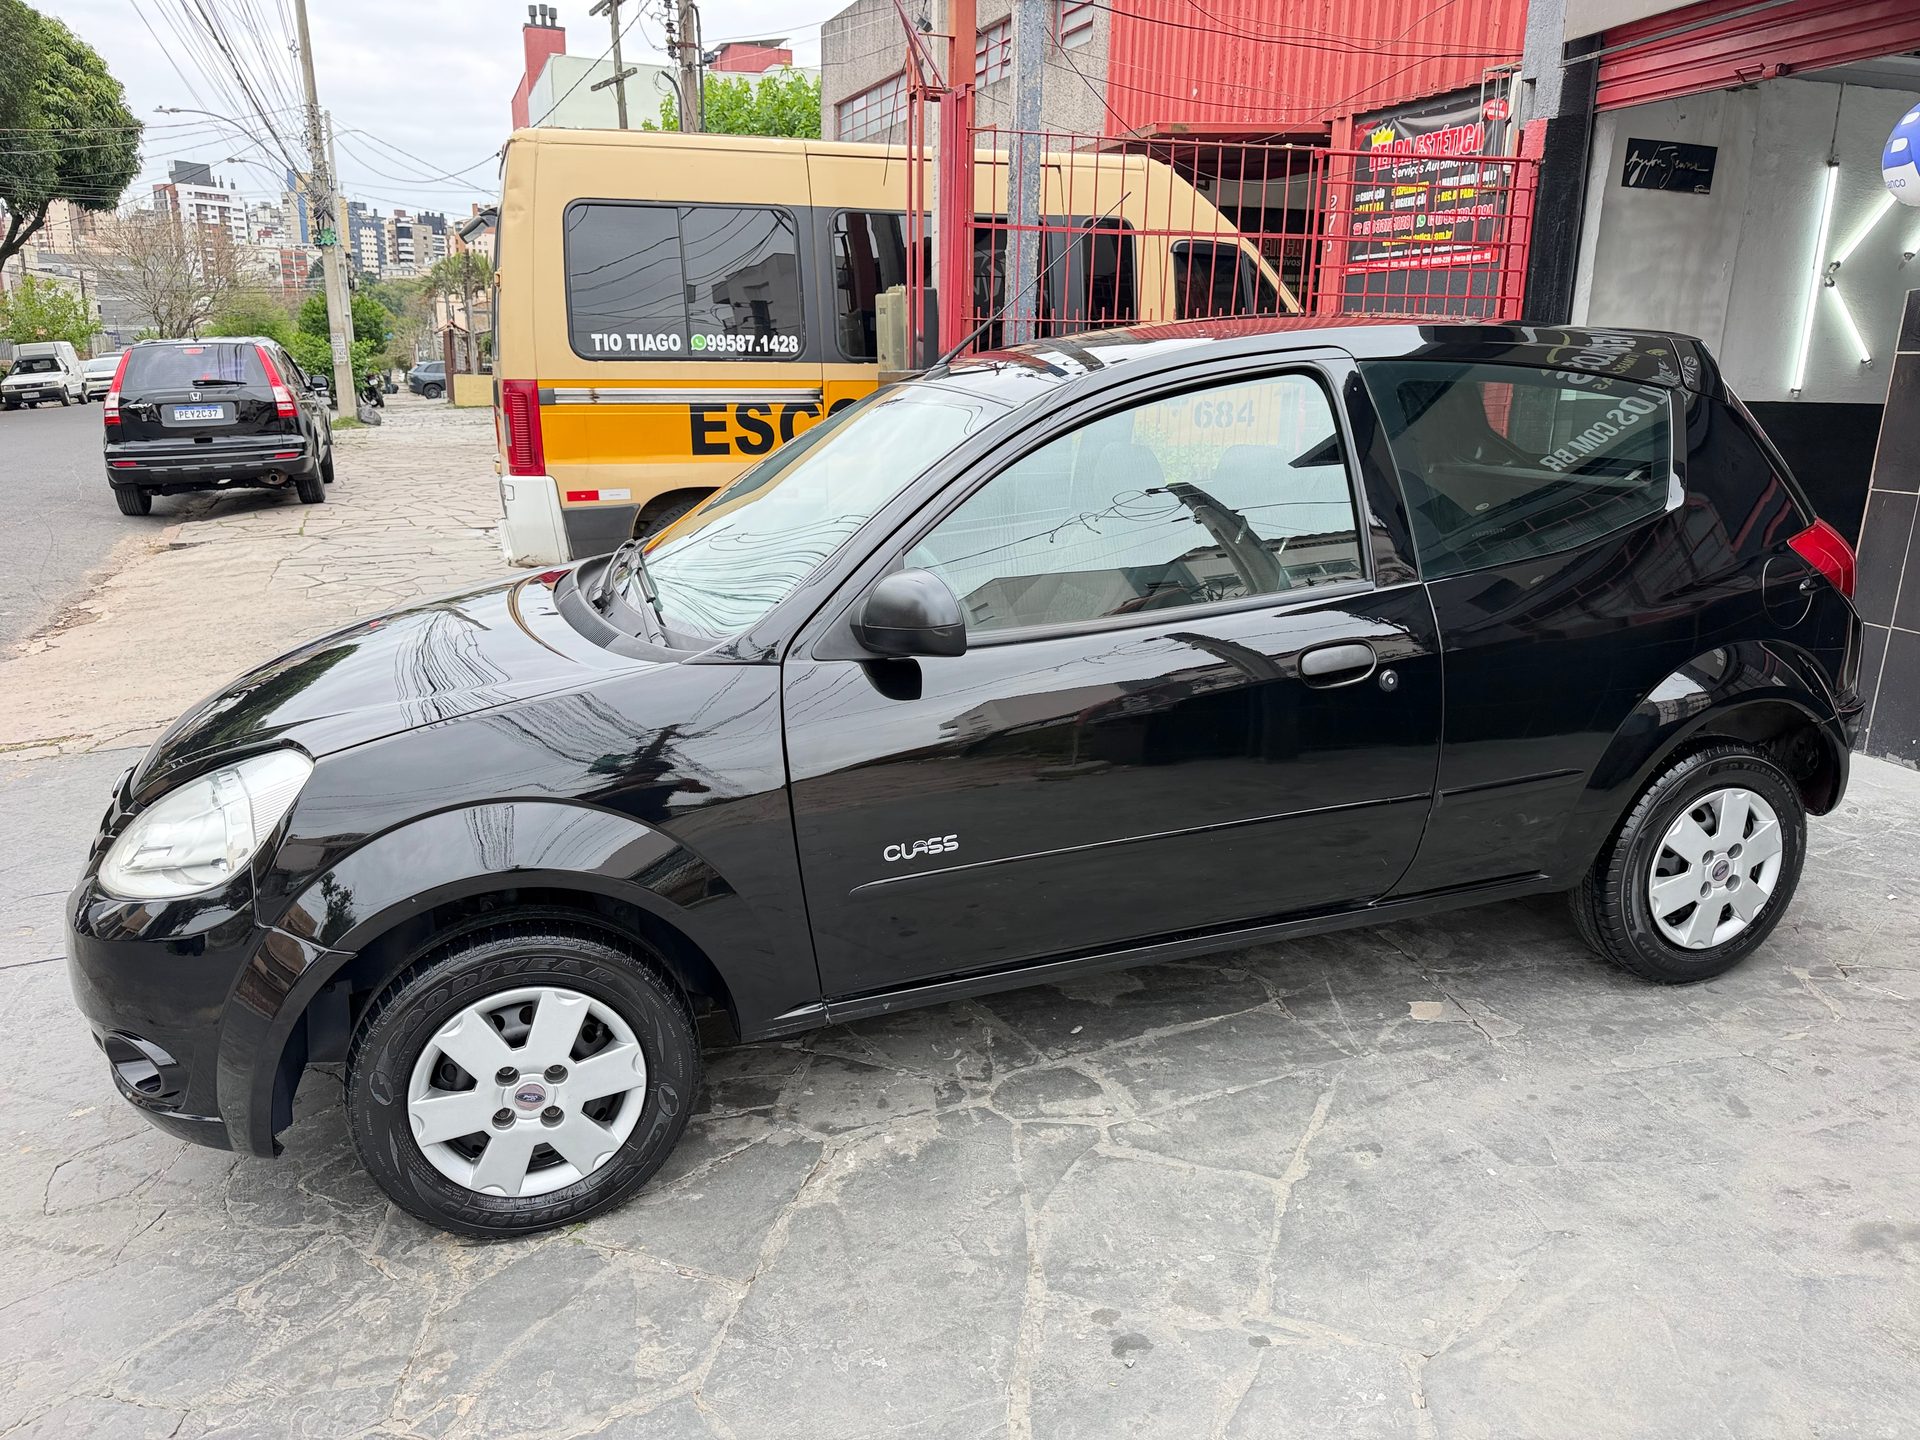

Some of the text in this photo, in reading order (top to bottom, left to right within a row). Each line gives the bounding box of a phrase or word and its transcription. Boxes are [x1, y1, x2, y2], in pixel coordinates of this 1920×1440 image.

[591, 333, 799, 353] TIO TIAGO 99587.1428
[178, 409, 219, 418] PEY2C37
[689, 398, 858, 456] ESC
[1193, 399, 1256, 429] 684
[883, 834, 959, 862] CLASS
